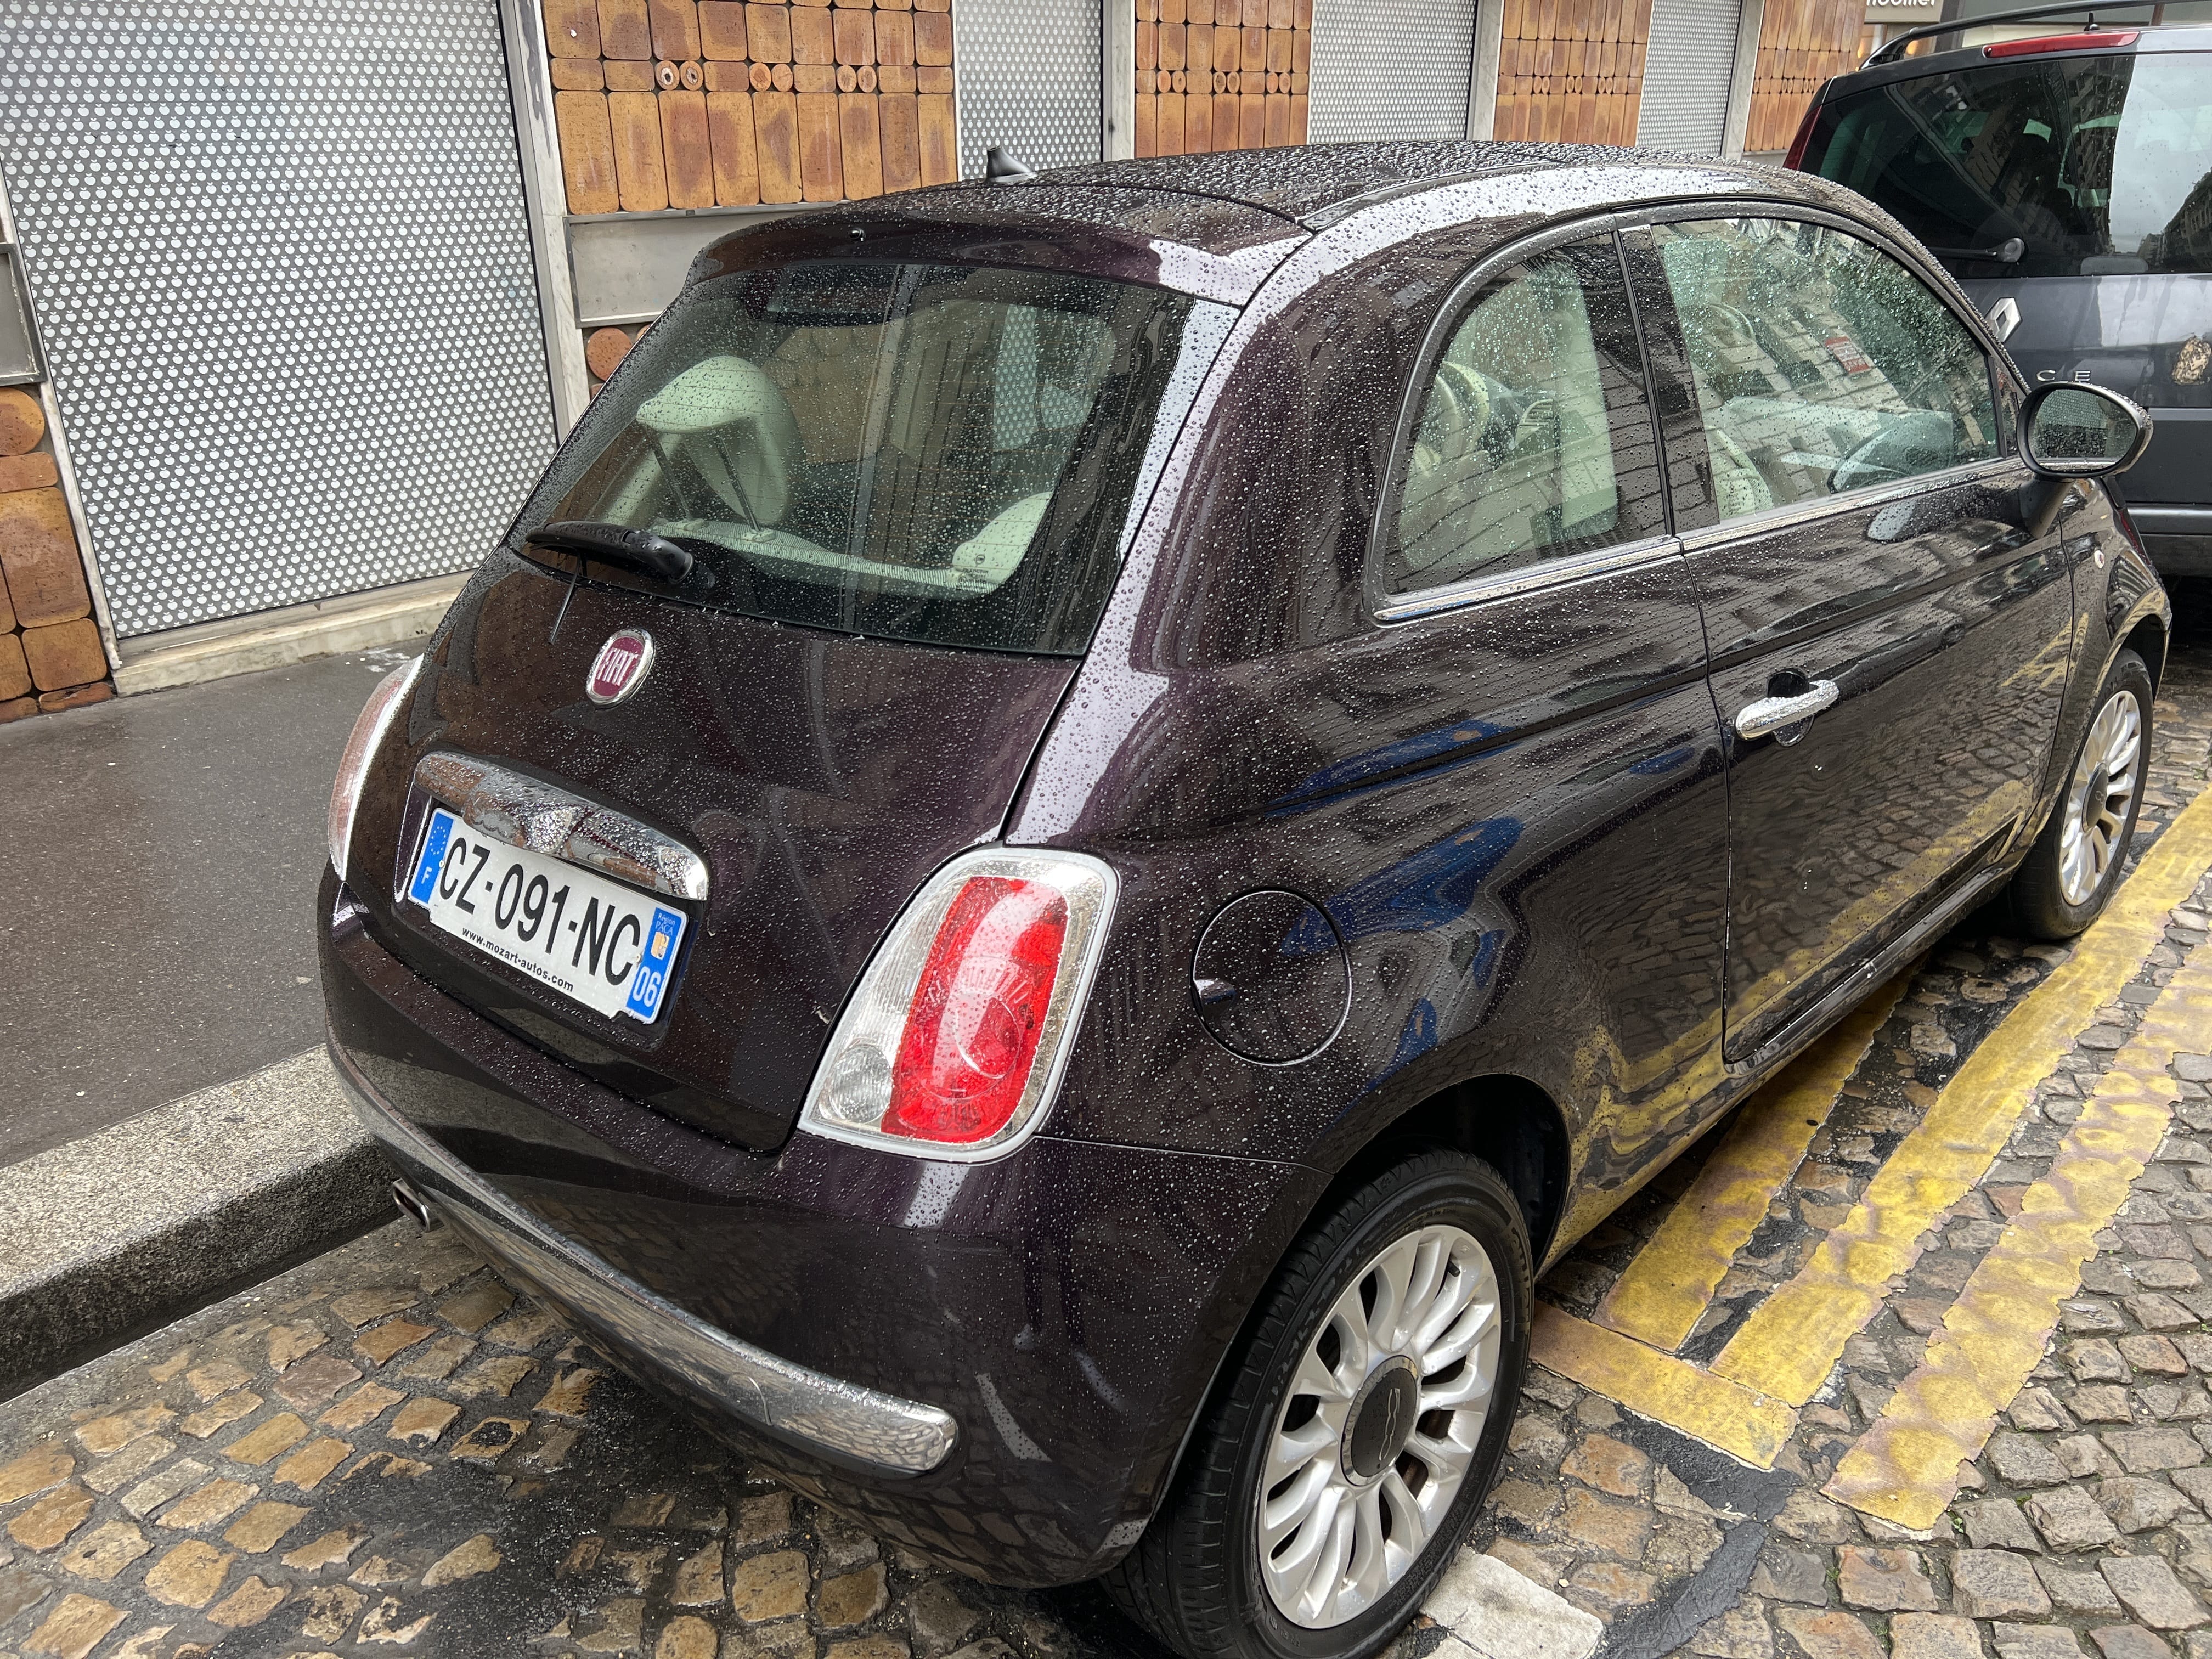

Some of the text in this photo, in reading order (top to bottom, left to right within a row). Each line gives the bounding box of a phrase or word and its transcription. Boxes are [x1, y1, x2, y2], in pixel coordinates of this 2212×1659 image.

[595, 647, 639, 686] FIAT
[421, 867, 432, 884] F
[439, 837, 640, 985] CZ-091-NC
[655, 921, 673, 936] PACA
[462, 927, 574, 992] www.mozart-autos.com
[633, 966, 661, 1007] 06
